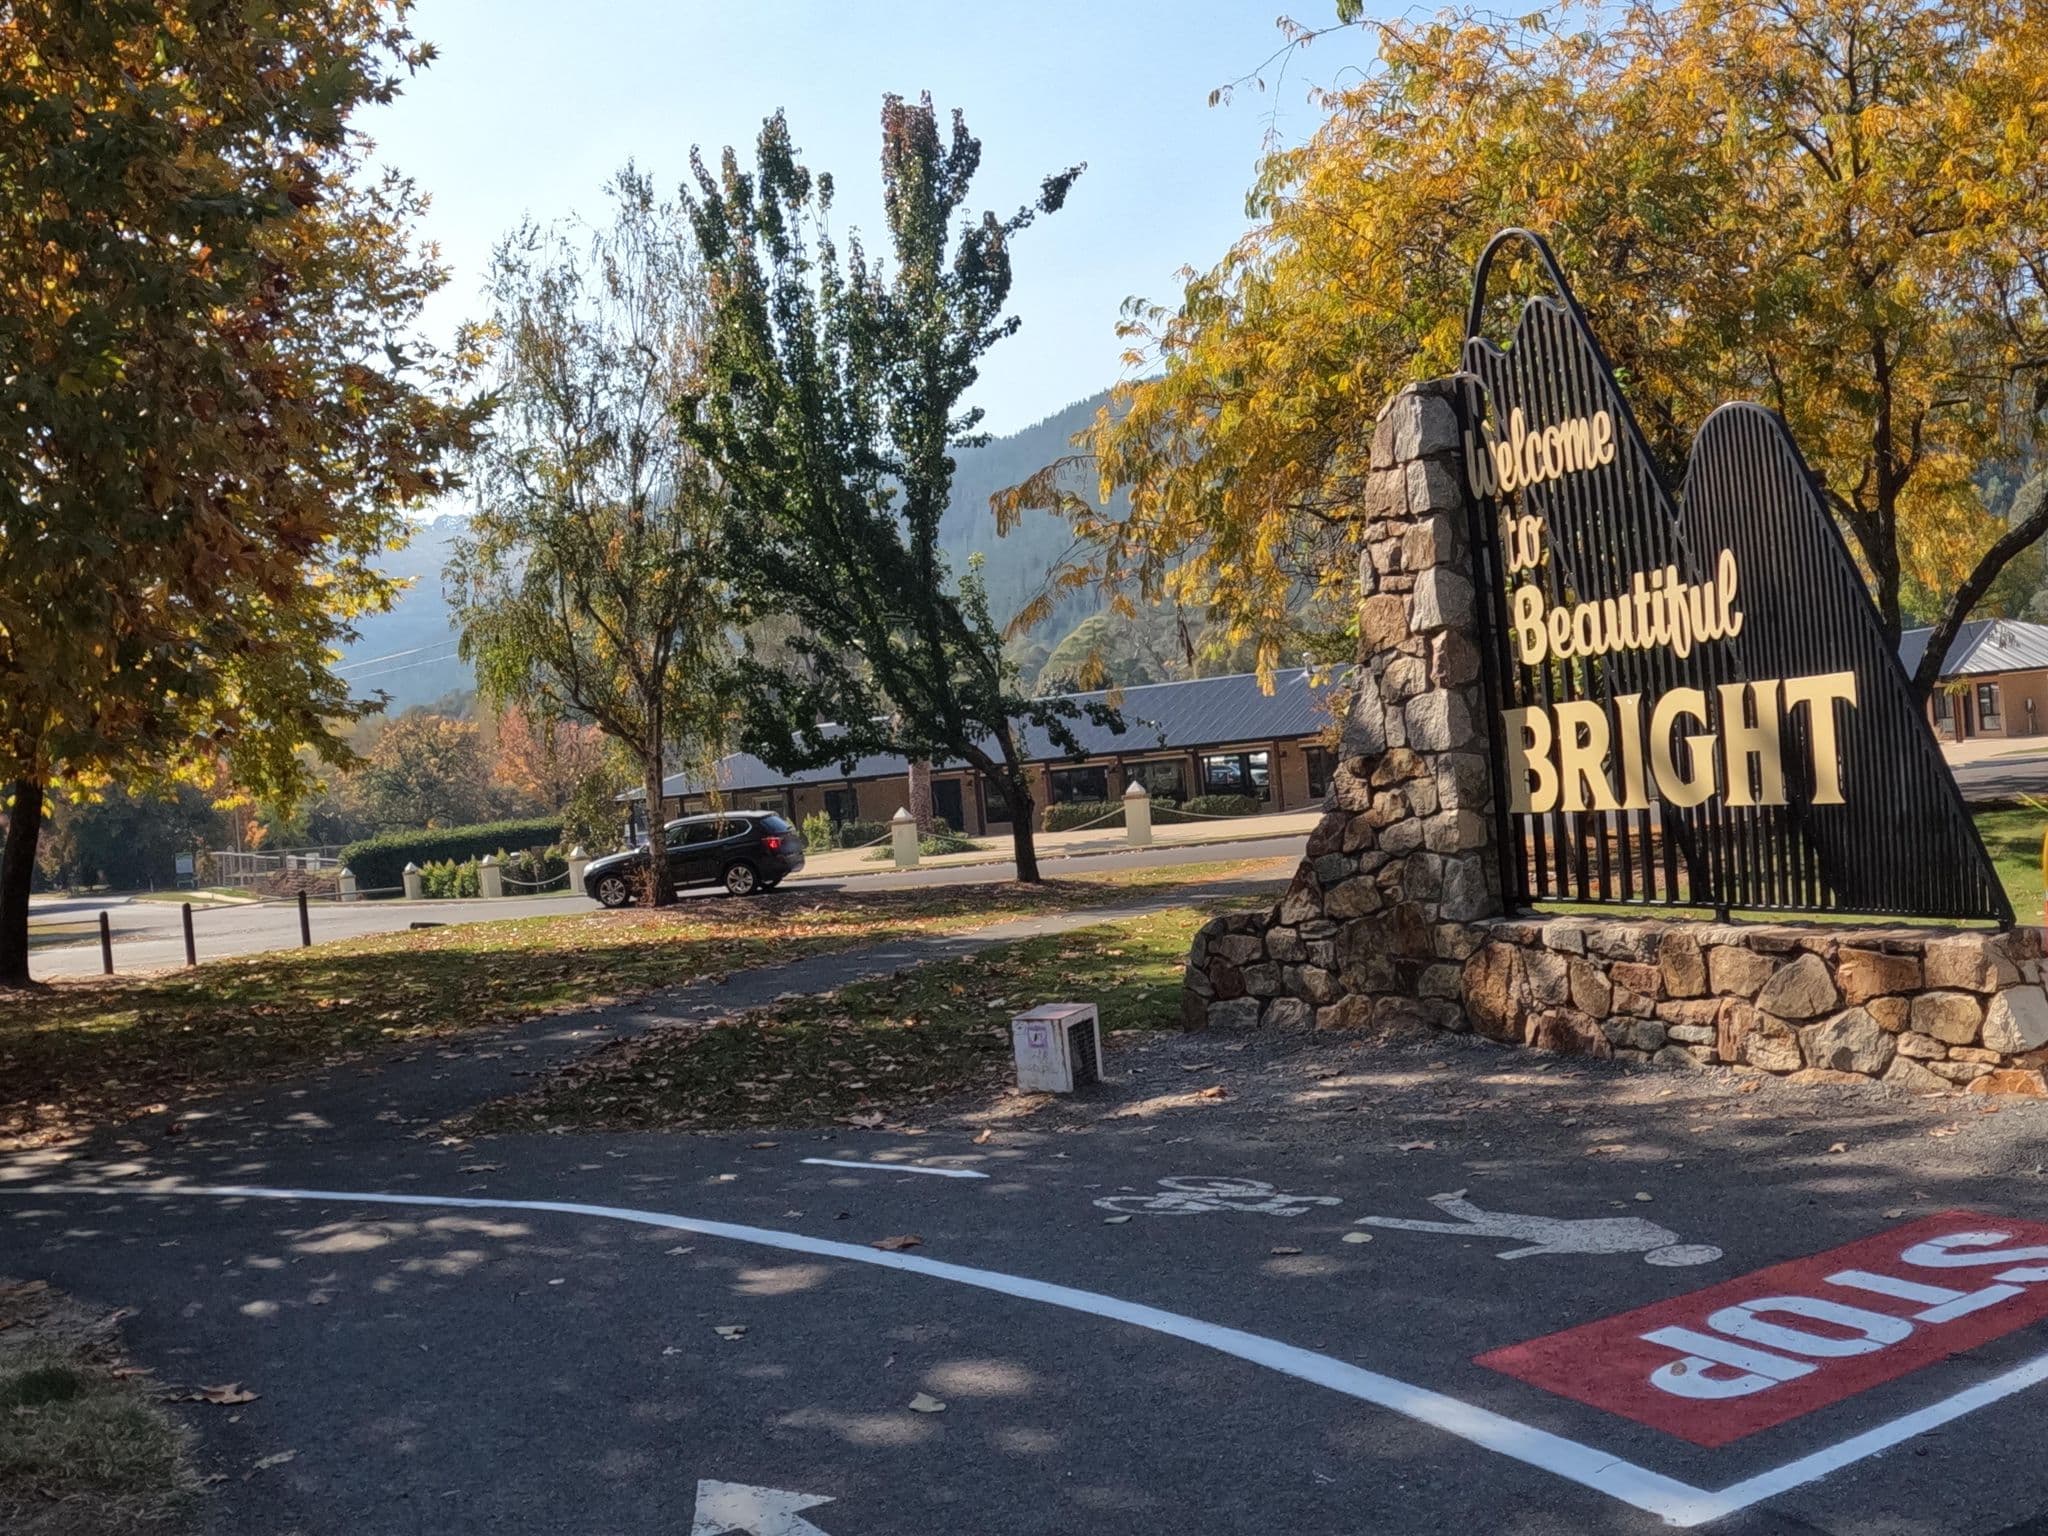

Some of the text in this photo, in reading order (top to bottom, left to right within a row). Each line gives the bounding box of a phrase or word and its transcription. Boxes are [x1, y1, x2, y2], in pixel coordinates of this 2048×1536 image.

[1464, 407, 1614, 499] Welcome
[1502, 505, 1543, 572] to
[1513, 548, 1744, 665] Beautiful
[1501, 671, 1857, 814] BRIGHT
[1639, 1231, 2048, 1399] STOP
